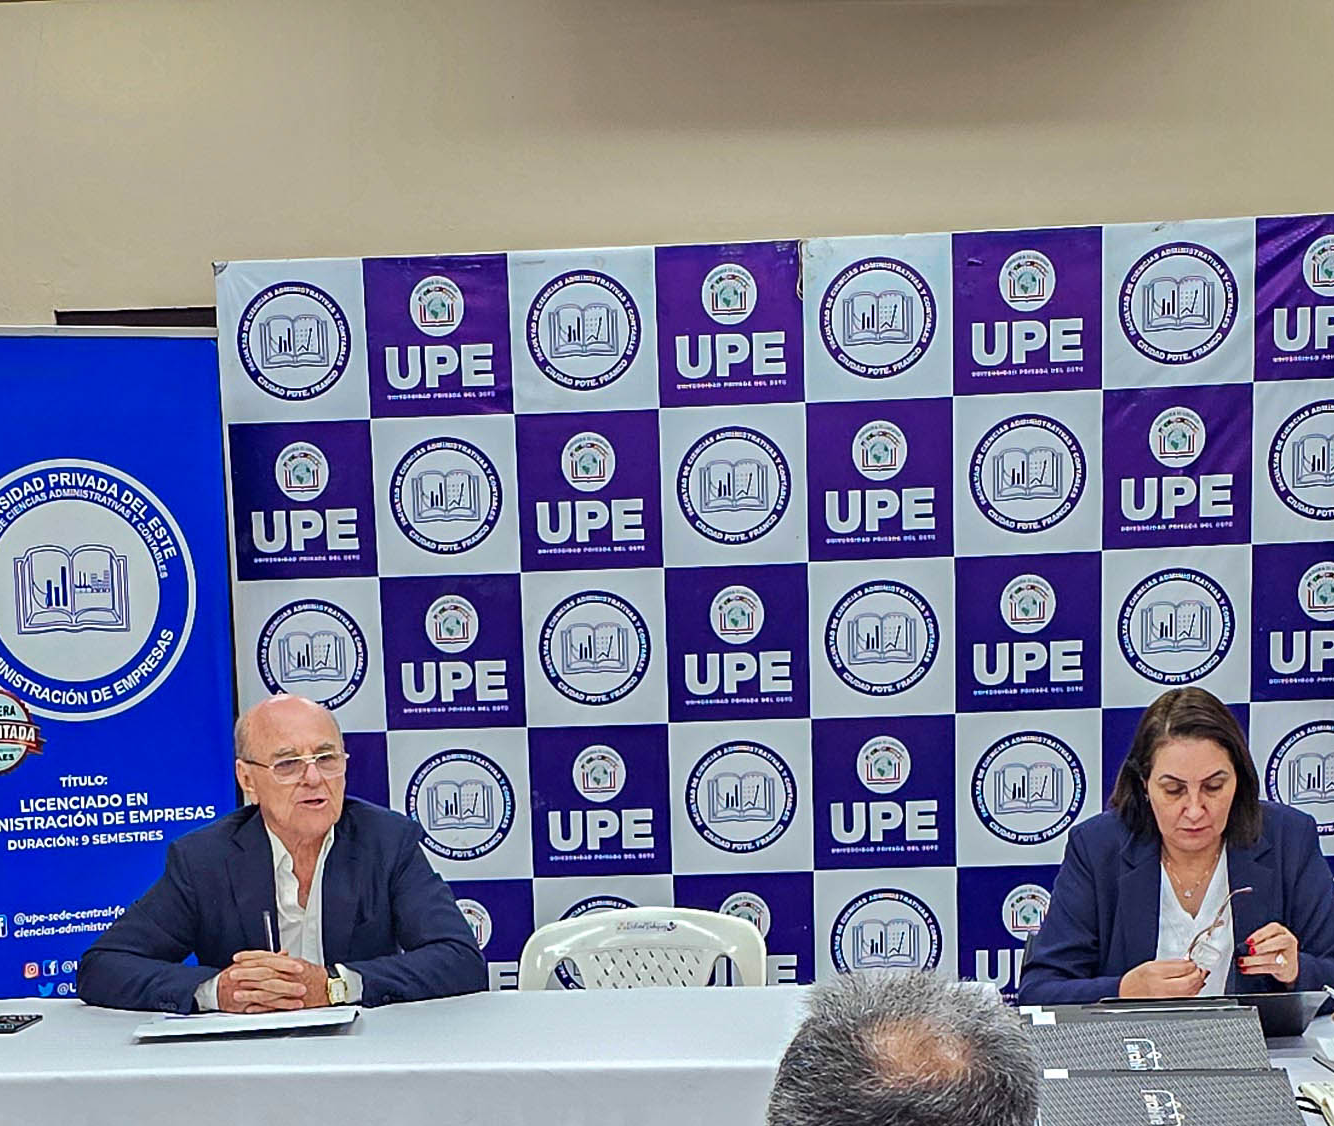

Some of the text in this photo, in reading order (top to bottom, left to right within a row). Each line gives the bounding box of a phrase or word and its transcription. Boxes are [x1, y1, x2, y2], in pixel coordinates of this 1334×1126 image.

[675, 331, 787, 379] UPE
[971, 318, 1084, 366] UPE
[384, 343, 495, 391] UPE
[48, 472, 119, 498] PRIVADA
[120, 491, 148, 520] DEL
[147, 517, 178, 560] ESTE
[824, 487, 936, 533] UPE
[1120, 474, 1234, 520] UPE
[5, 492, 47, 522] CIENCIAS
[49, 488, 133, 518] ADMINISTRATIVAS
[130, 515, 139, 524] Y
[136, 522, 168, 580] CONTABLES
[251, 508, 360, 553] UPE
[535, 498, 645, 544] UPE
[91, 688, 113, 704] DE
[113, 629, 174, 695] EMPRESAS
[401, 660, 509, 704] UPE
[683, 651, 794, 695] UPE
[973, 639, 1084, 686] UPE
[20, 792, 148, 813] LICENCIADO EN
[60, 775, 108, 788] TÍTULO:
[103, 811, 125, 825] DE
[129, 805, 216, 824] EMPRESAS
[548, 808, 654, 852] UPE
[830, 799, 939, 844] UPE
[7, 830, 164, 851] DURACIÓN: 9 SEMESTRES
